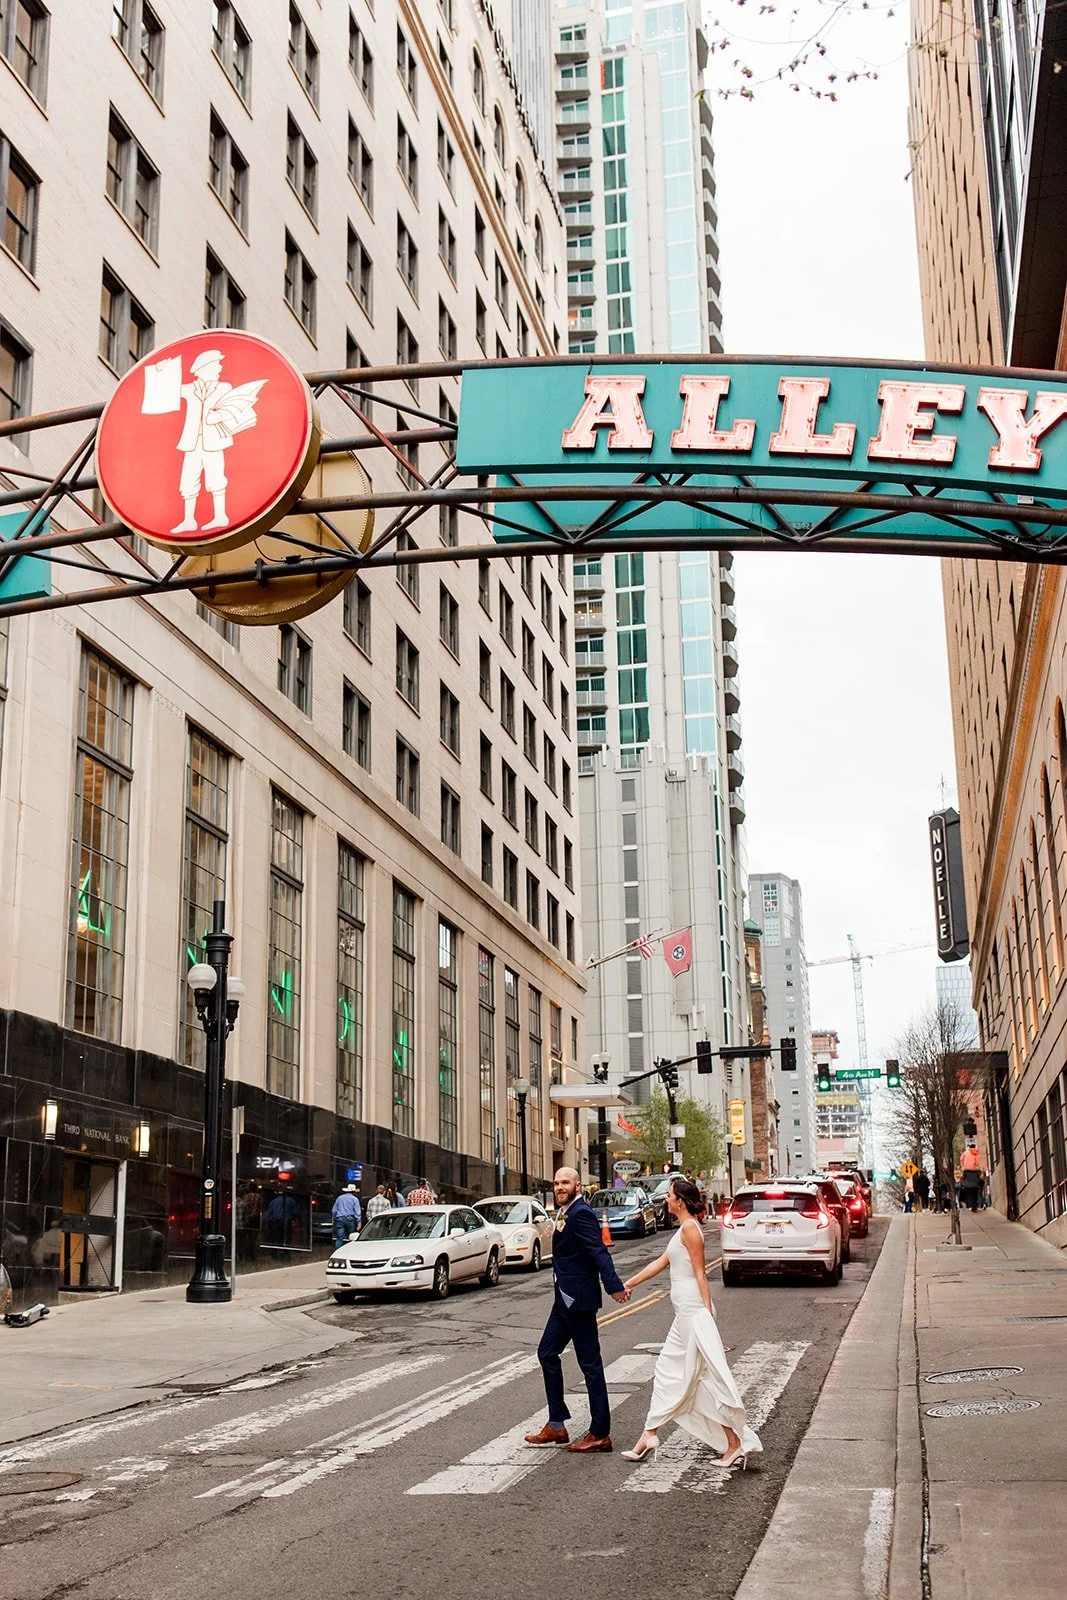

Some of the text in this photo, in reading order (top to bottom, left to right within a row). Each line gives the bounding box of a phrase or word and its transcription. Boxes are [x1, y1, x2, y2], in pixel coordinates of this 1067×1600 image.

[561, 374, 1067, 471] ALLEY
[932, 829, 948, 939] NOELLE
[64, 1123, 130, 1145] THIRD NATIONAL BANK
